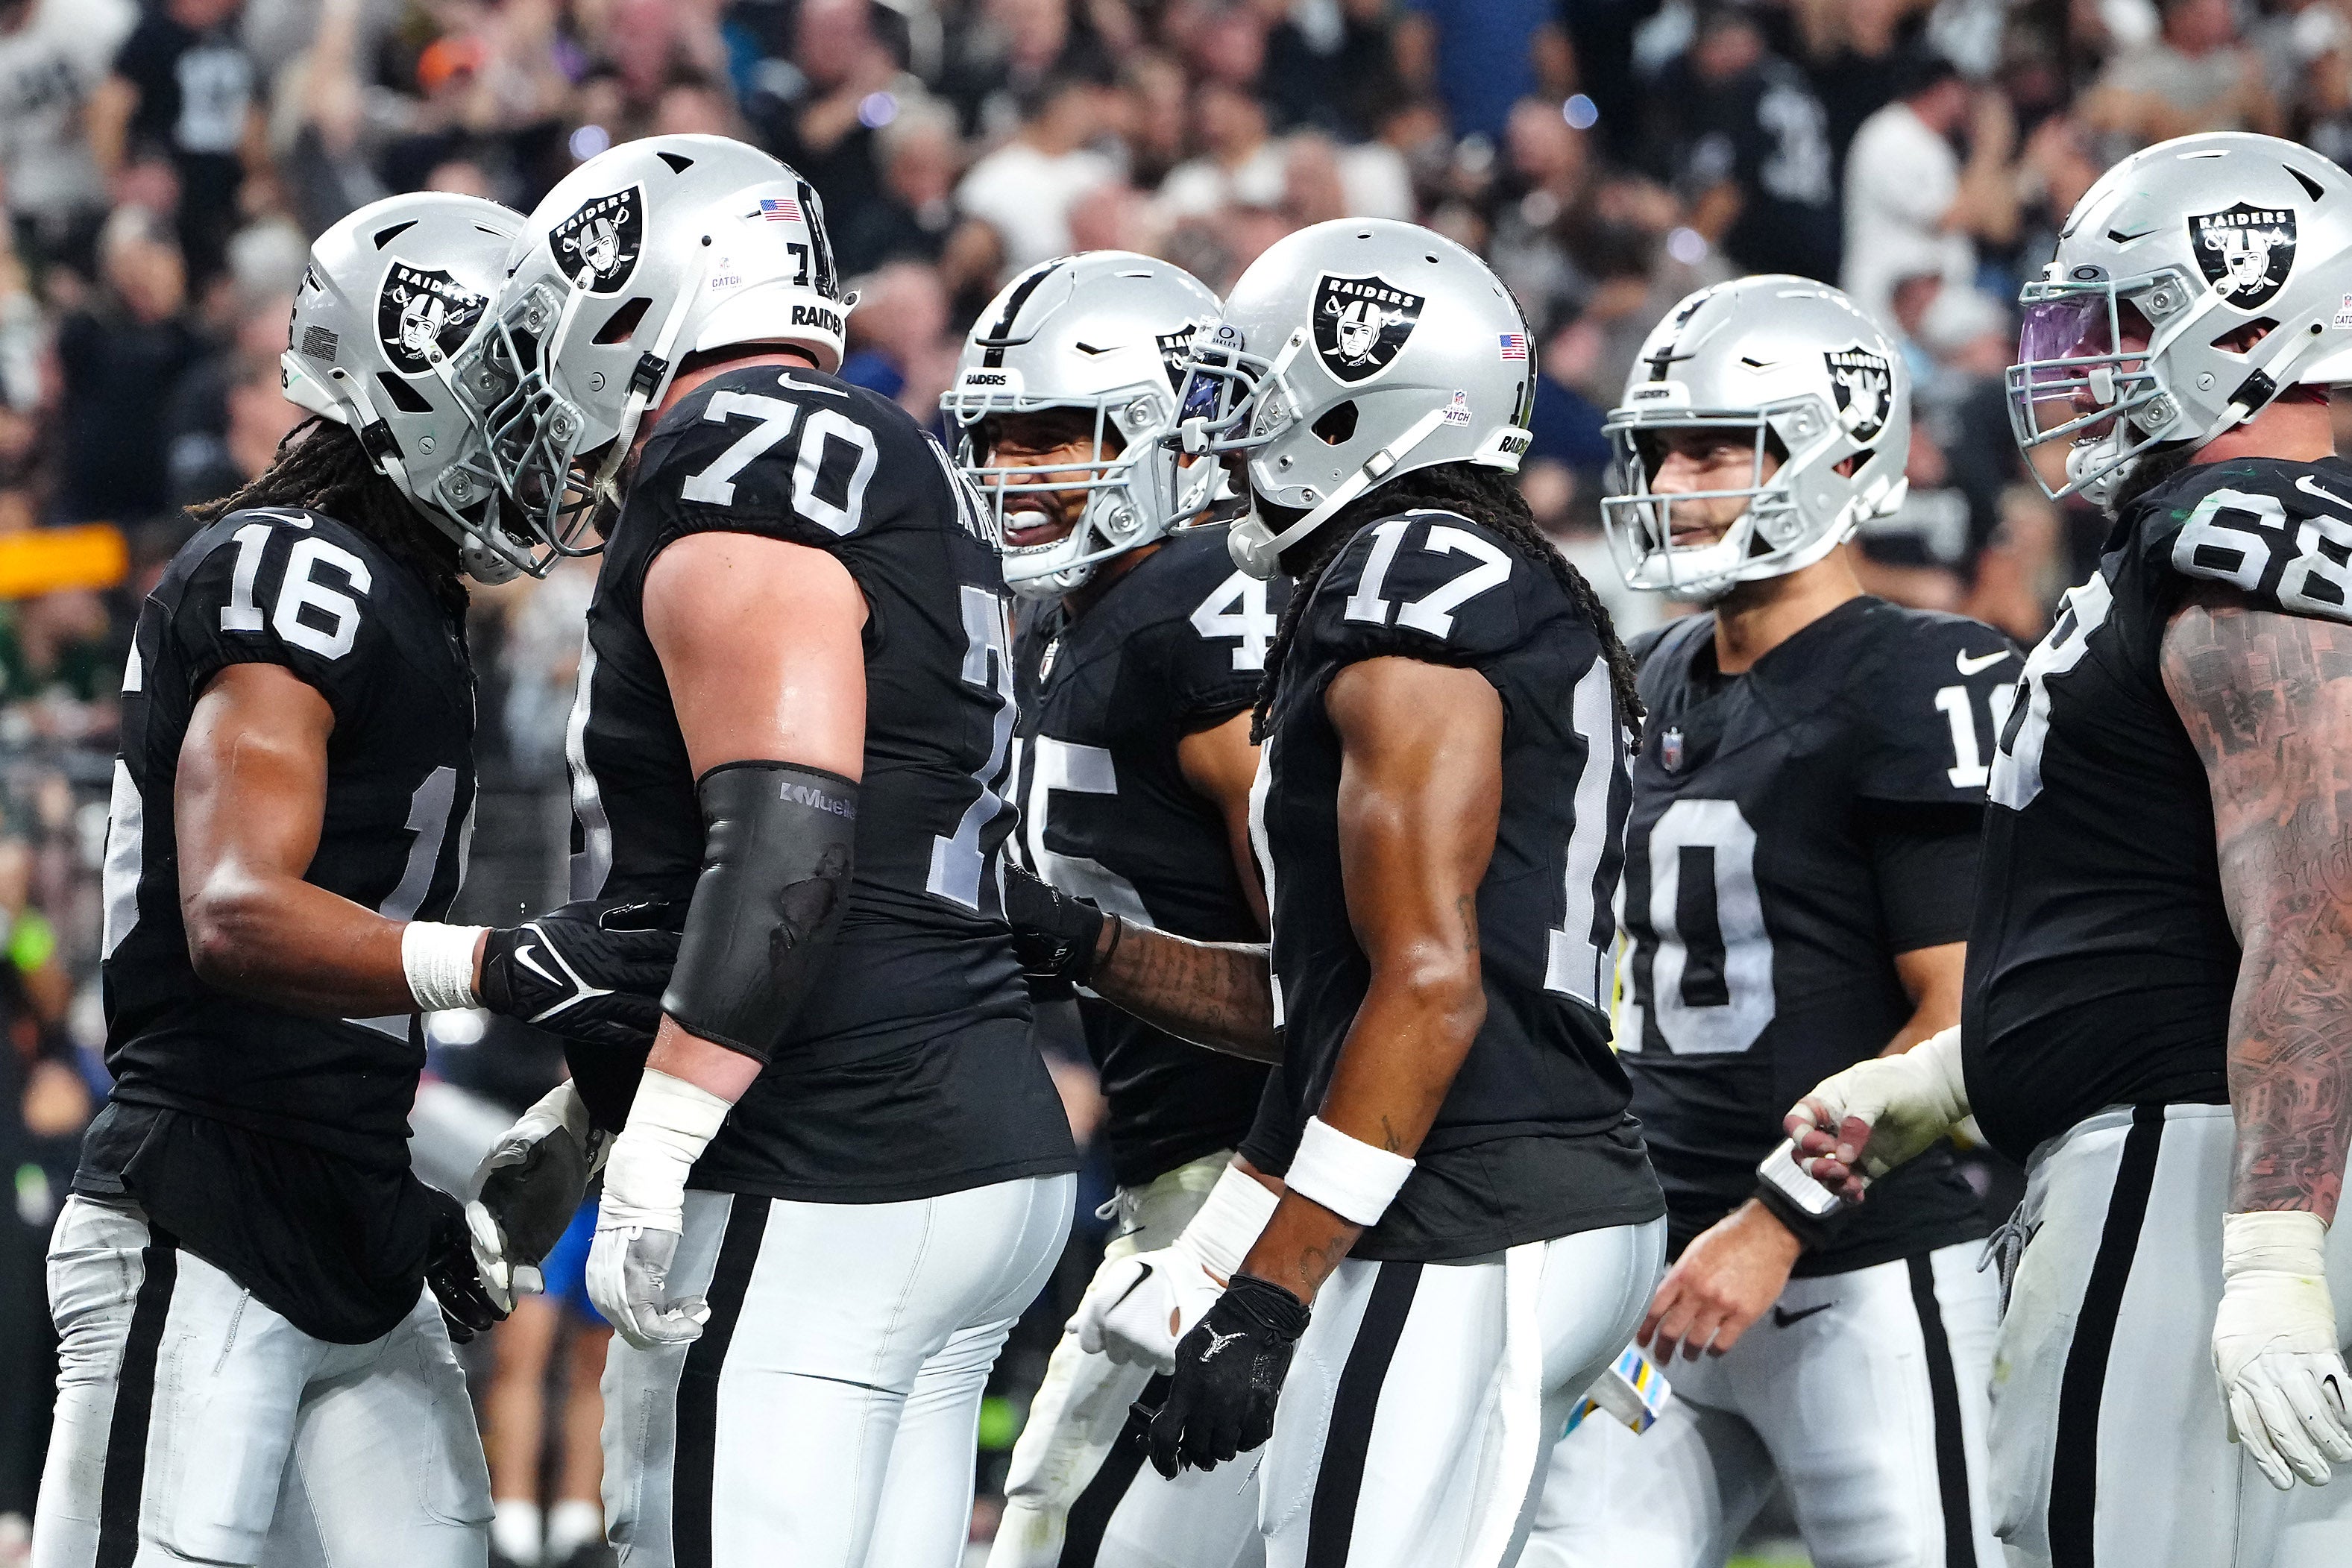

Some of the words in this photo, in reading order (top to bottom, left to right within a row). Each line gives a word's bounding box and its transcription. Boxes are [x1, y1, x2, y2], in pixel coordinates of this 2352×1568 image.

[556, 191, 631, 239] RAIDERS
[2198, 211, 2286, 230] RAIDERS
[397, 268, 483, 307] RAIDRS
[712, 275, 742, 288] CATCH
[791, 305, 843, 343] RAIDE
[1327, 279, 1415, 307] RAIDERS
[966, 374, 1007, 385] RAIDERS
[1829, 353, 1887, 371] RAIDERS
[681, 391, 878, 537] 70
[220, 523, 373, 661] 16
[1344, 520, 1513, 640] 17
[2172, 488, 2352, 625] 68
[1189, 569, 1279, 670] 4
[925, 585, 1021, 911] 7
[1009, 734, 1153, 926] 5
[1544, 655, 1632, 1022] 1
[343, 766, 475, 1044] 1
